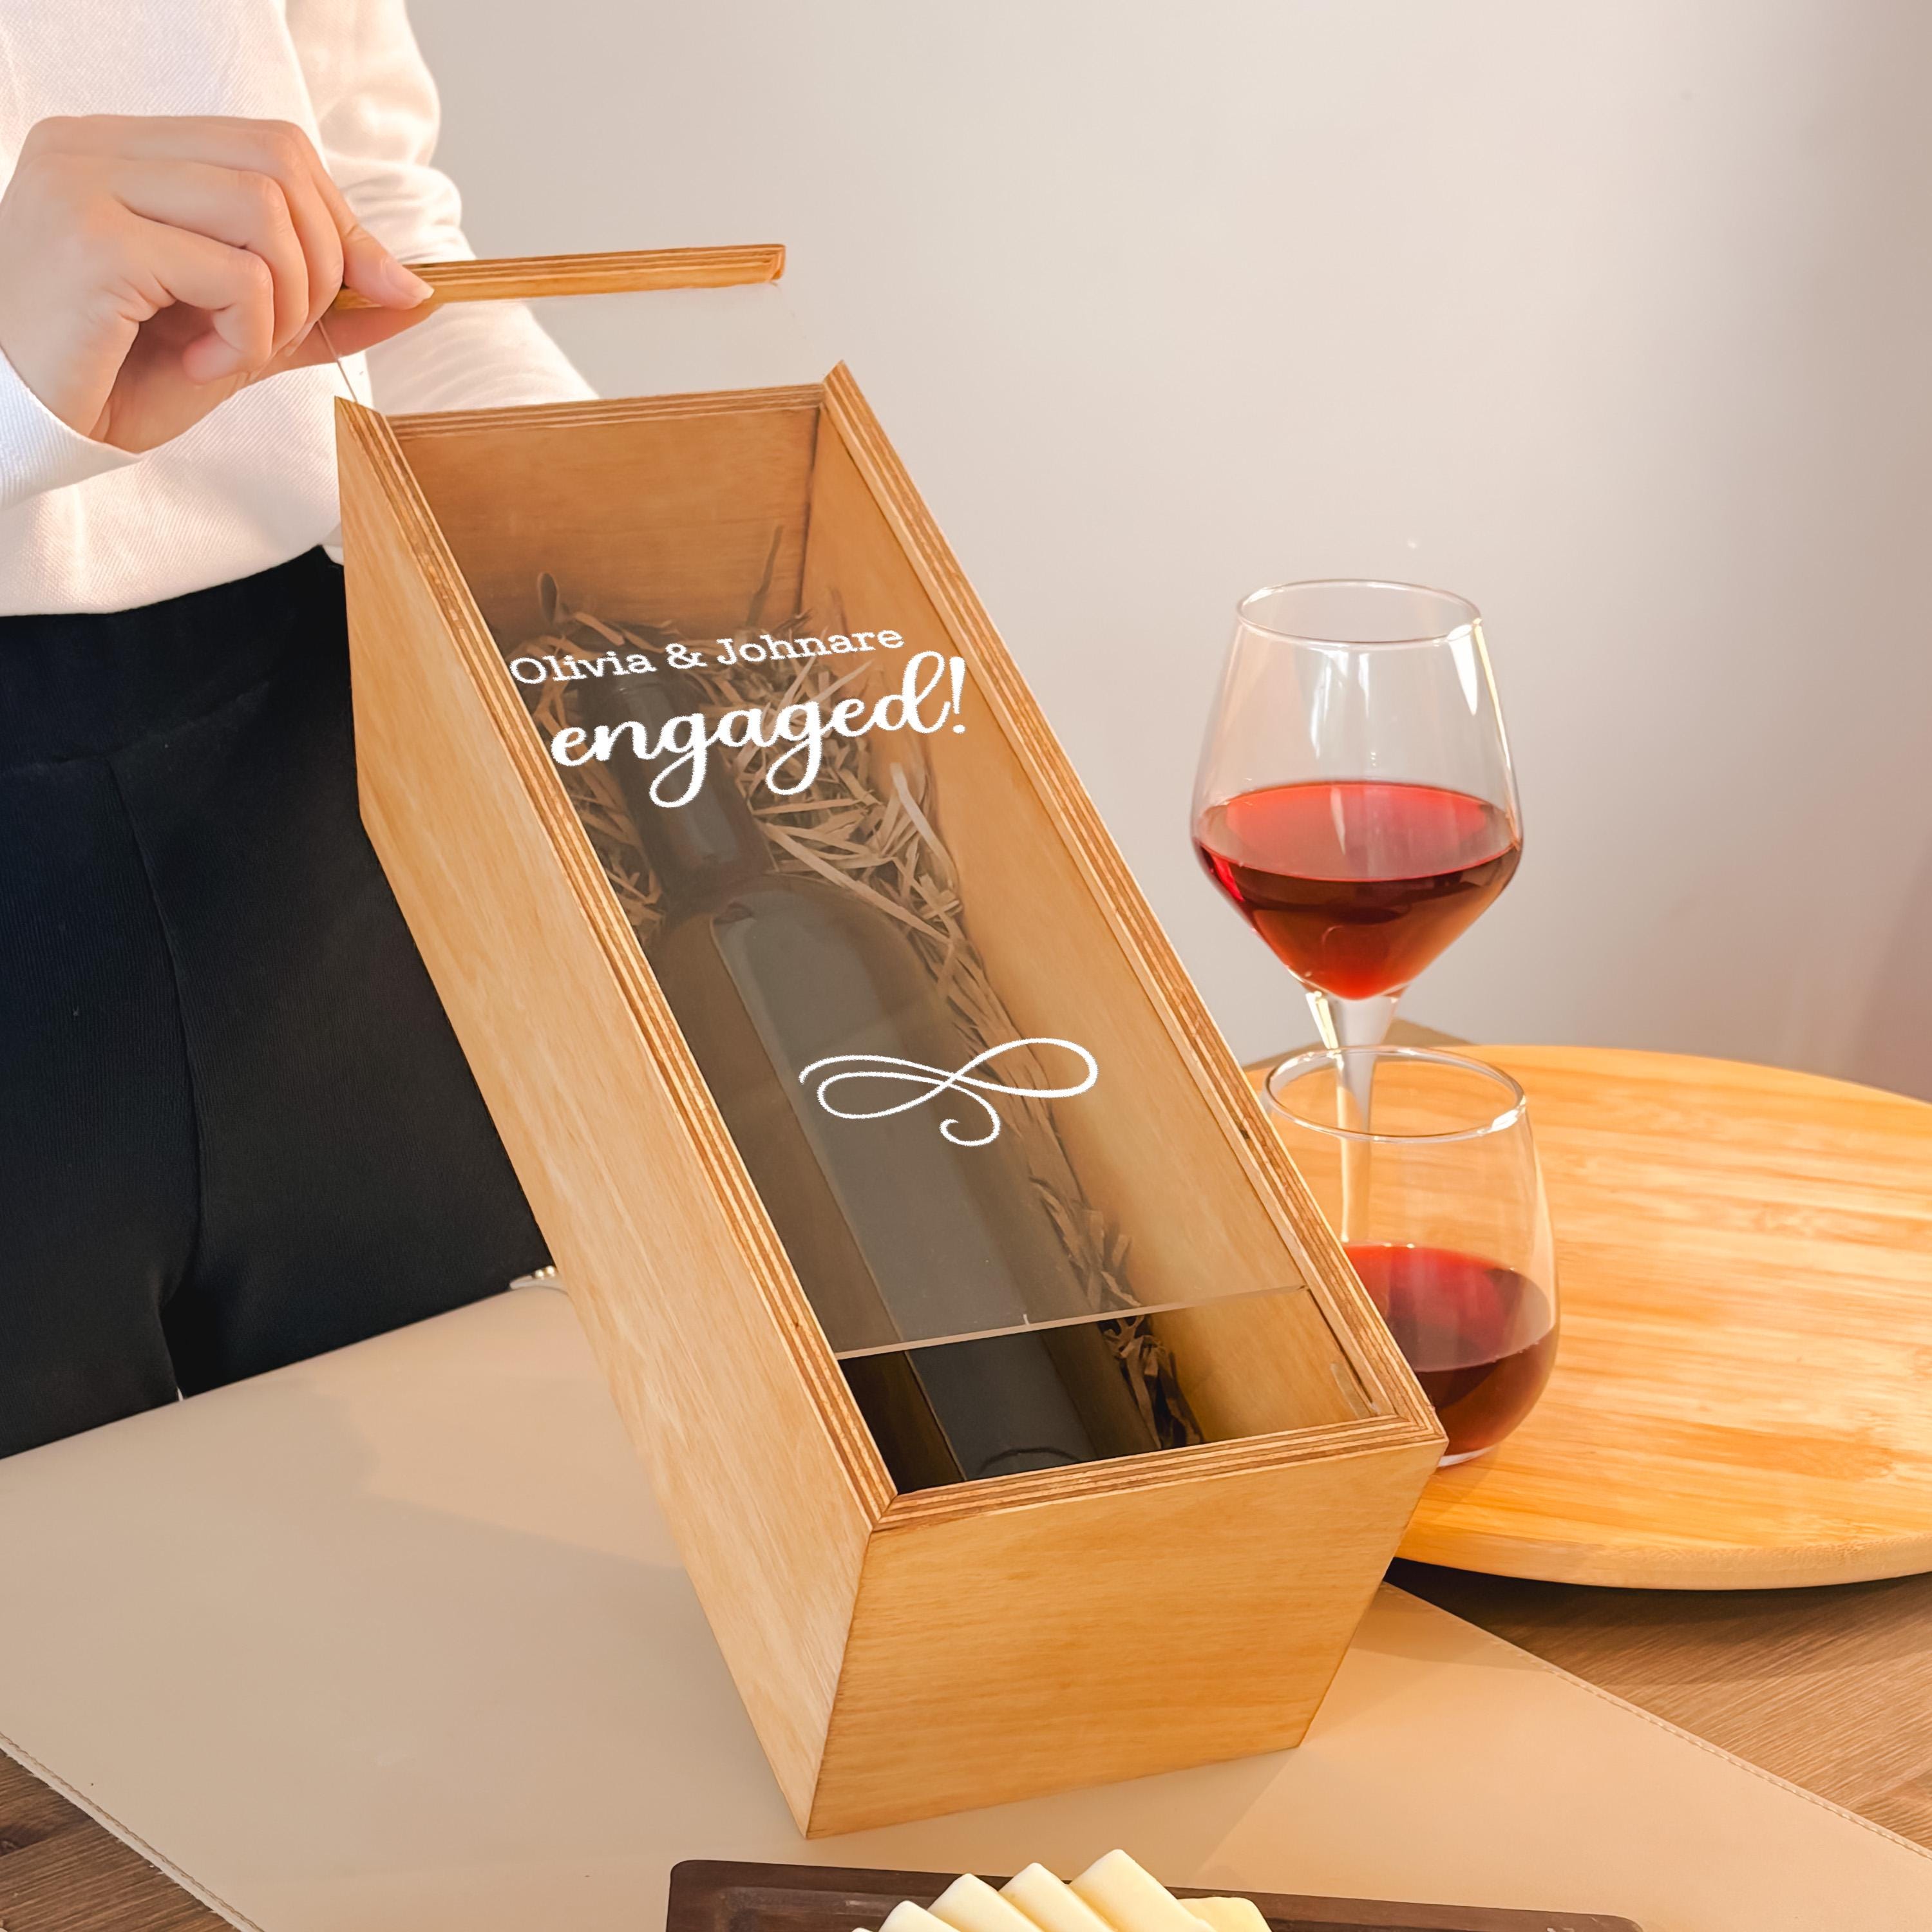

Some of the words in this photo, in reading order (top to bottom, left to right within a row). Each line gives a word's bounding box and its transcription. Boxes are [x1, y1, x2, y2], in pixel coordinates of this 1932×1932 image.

[509, 650, 657, 685] Olivia
[665, 643, 707, 670] &
[716, 630, 904, 665] Johnare
[551, 650, 967, 808] engaged!
